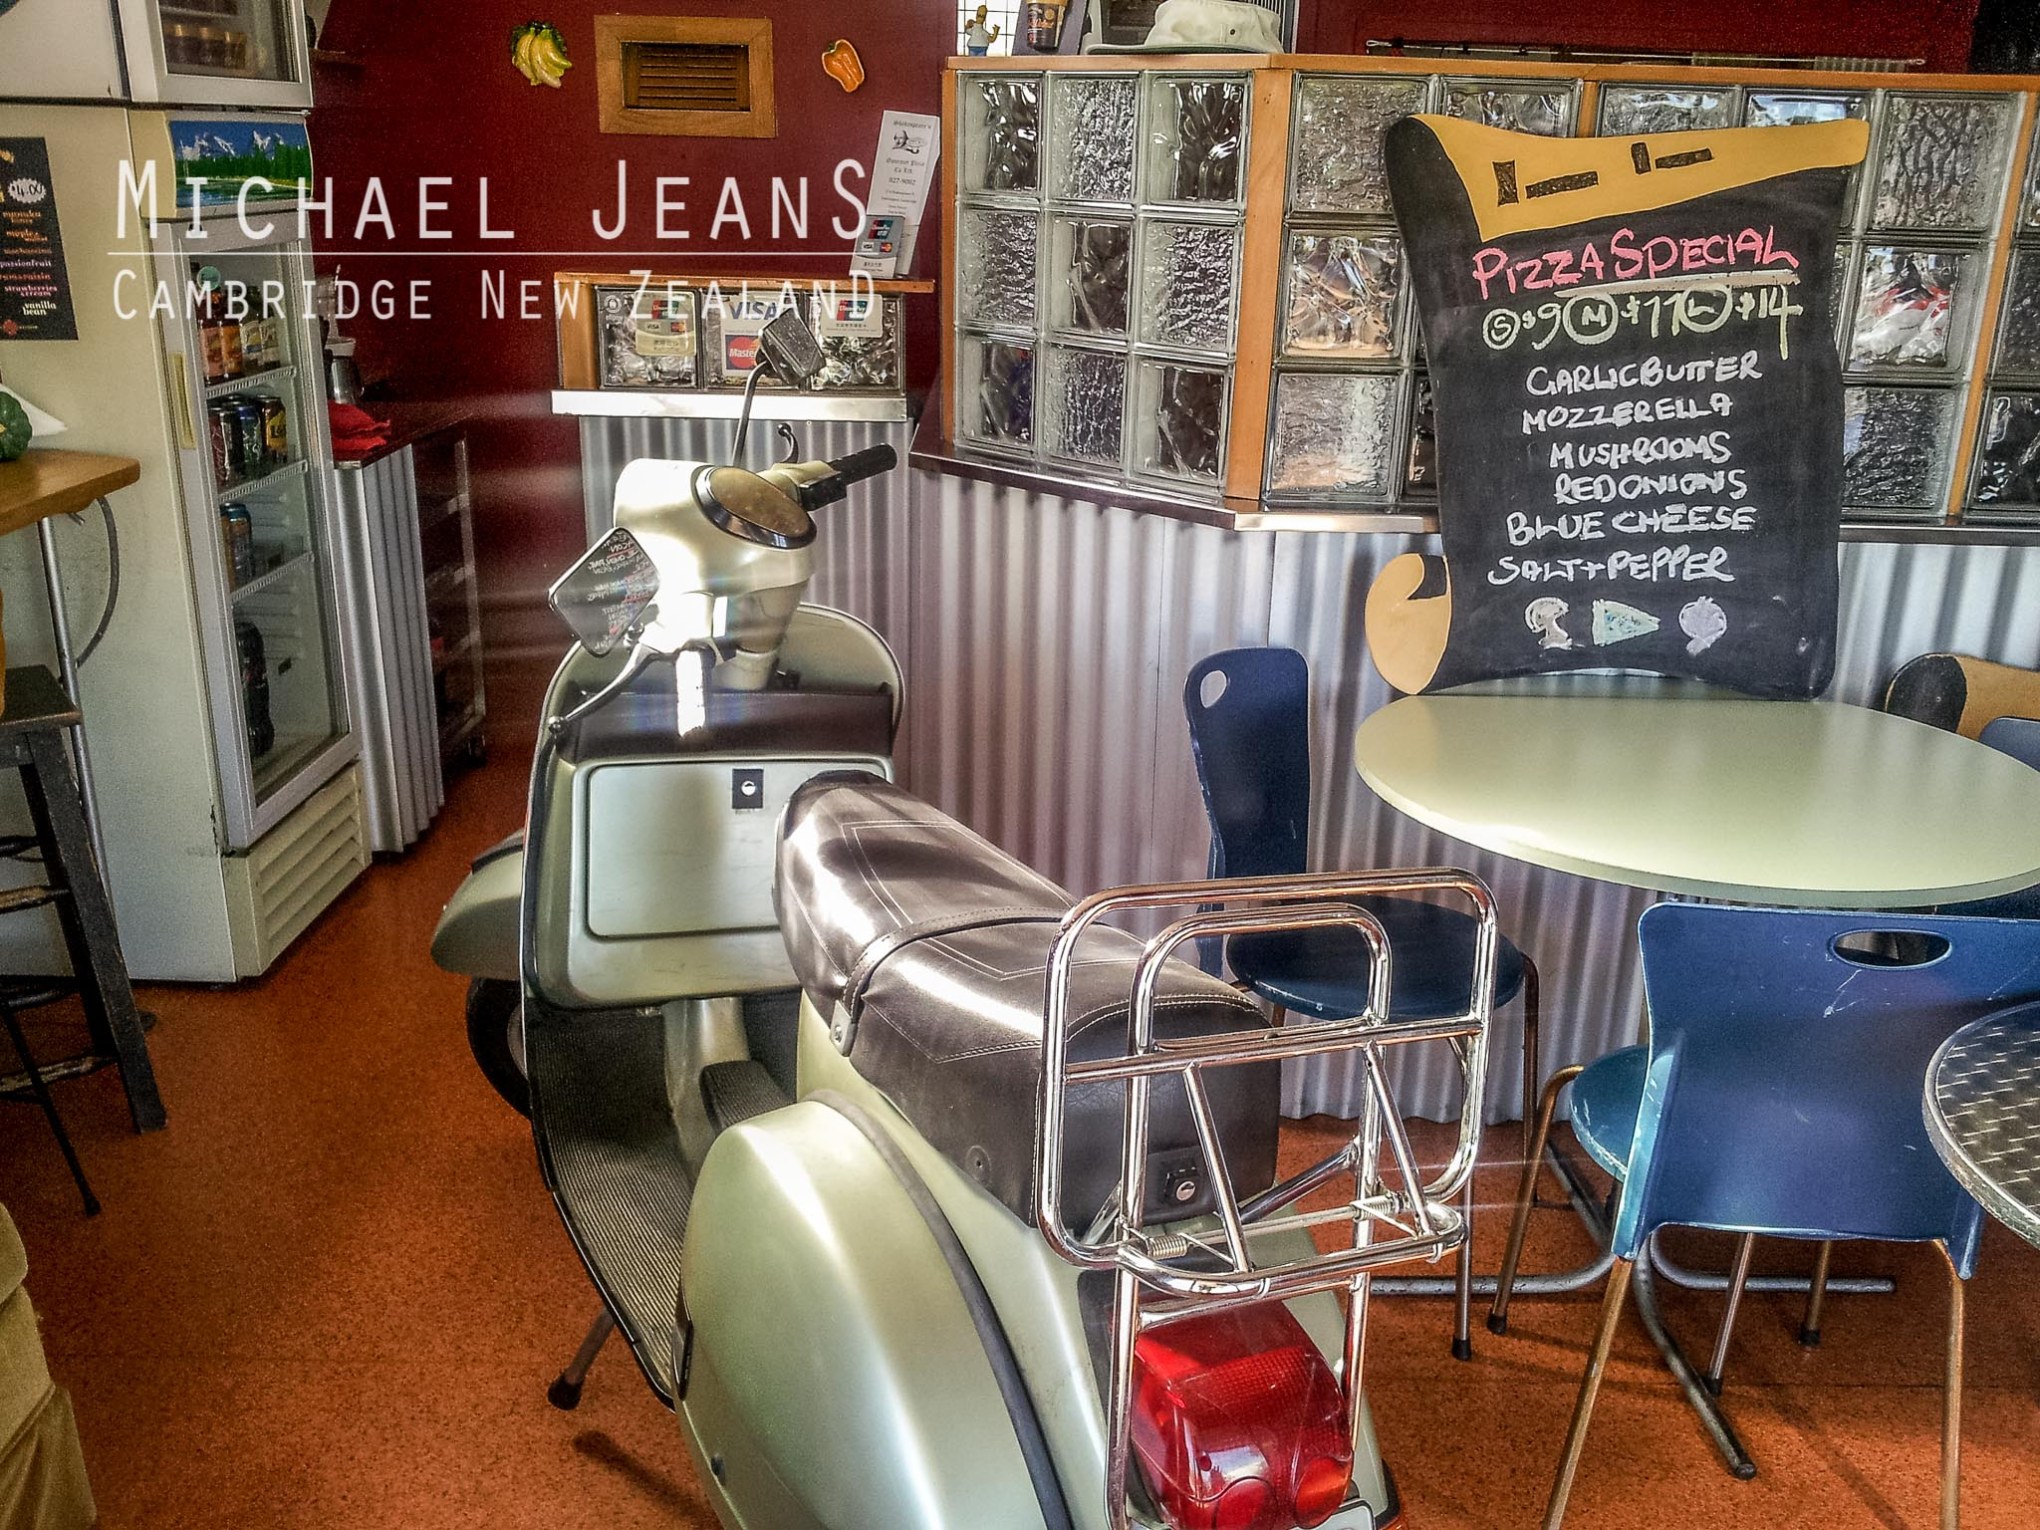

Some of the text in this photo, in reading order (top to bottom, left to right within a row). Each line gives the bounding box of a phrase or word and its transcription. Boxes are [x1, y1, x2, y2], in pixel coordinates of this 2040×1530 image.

[1472, 225, 1800, 300] PIZZA SPECIAL
[22, 306, 47, 315] bean
[24, 301, 57, 309] vanilla
[1522, 392, 1733, 435] MOZZERELLA
[1549, 430, 1732, 470] MUSHROOMS
[1506, 503, 1758, 546] BLUE CHEESE
